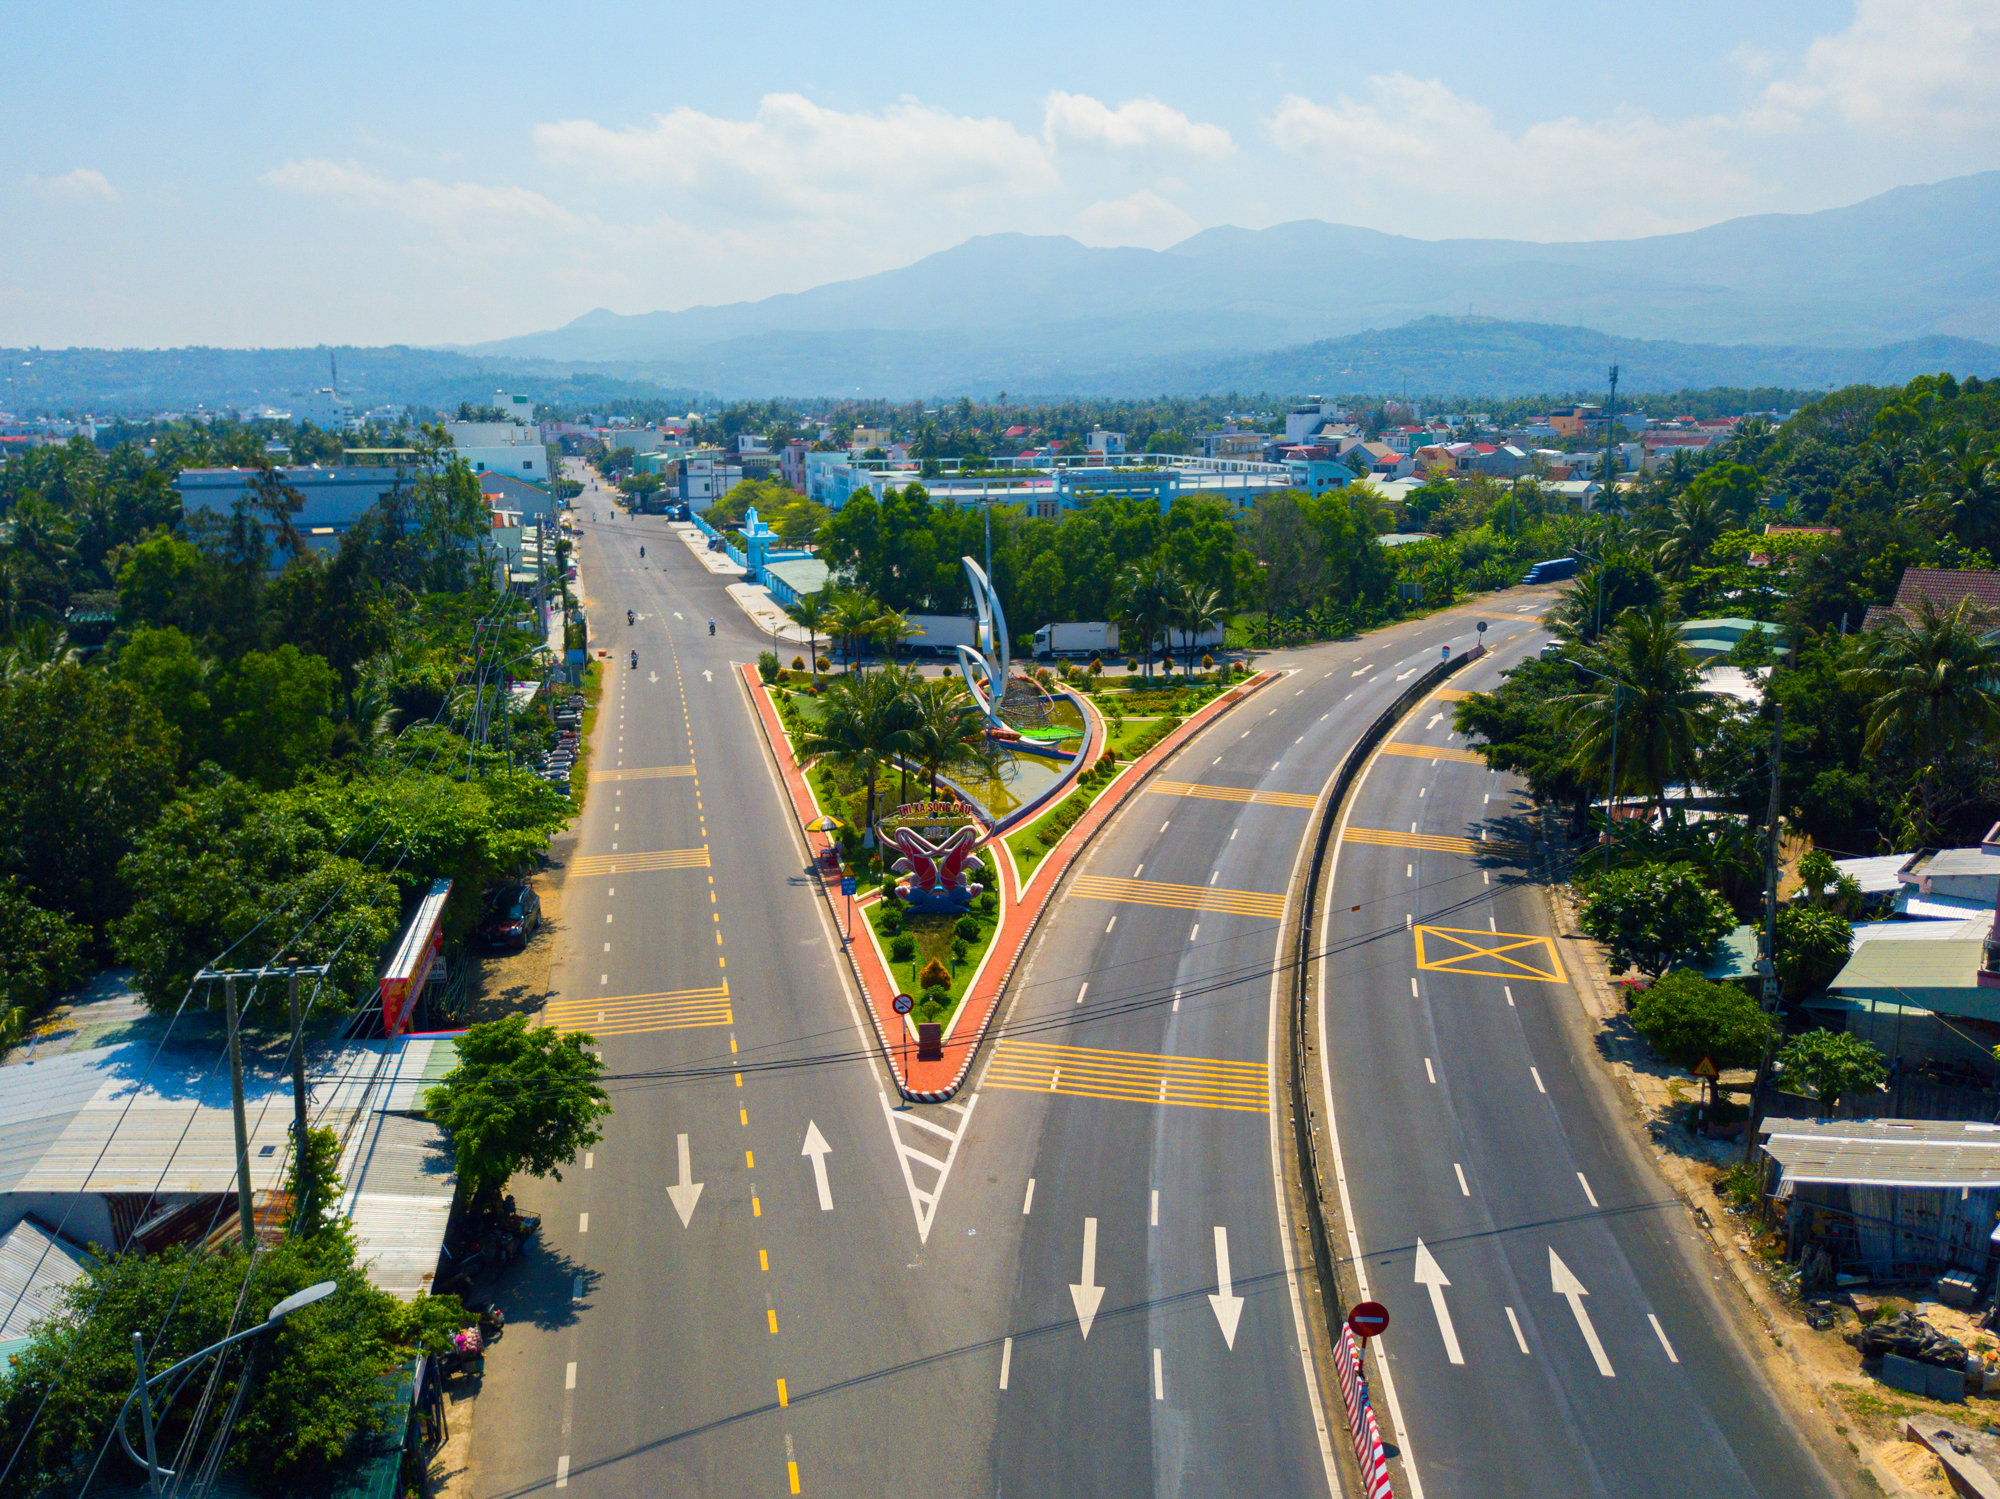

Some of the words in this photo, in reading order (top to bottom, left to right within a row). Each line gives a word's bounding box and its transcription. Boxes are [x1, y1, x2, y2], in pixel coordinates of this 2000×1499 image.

[897, 803, 912, 816] THỊ
[913, 800, 926, 813] XÃ
[928, 799, 951, 812] SÔNG
[953, 800, 972, 815] CẦU
[898, 816, 915, 826] KÍNH
[916, 816, 934, 826] CHÀO
[923, 827, 950, 839] 2024
